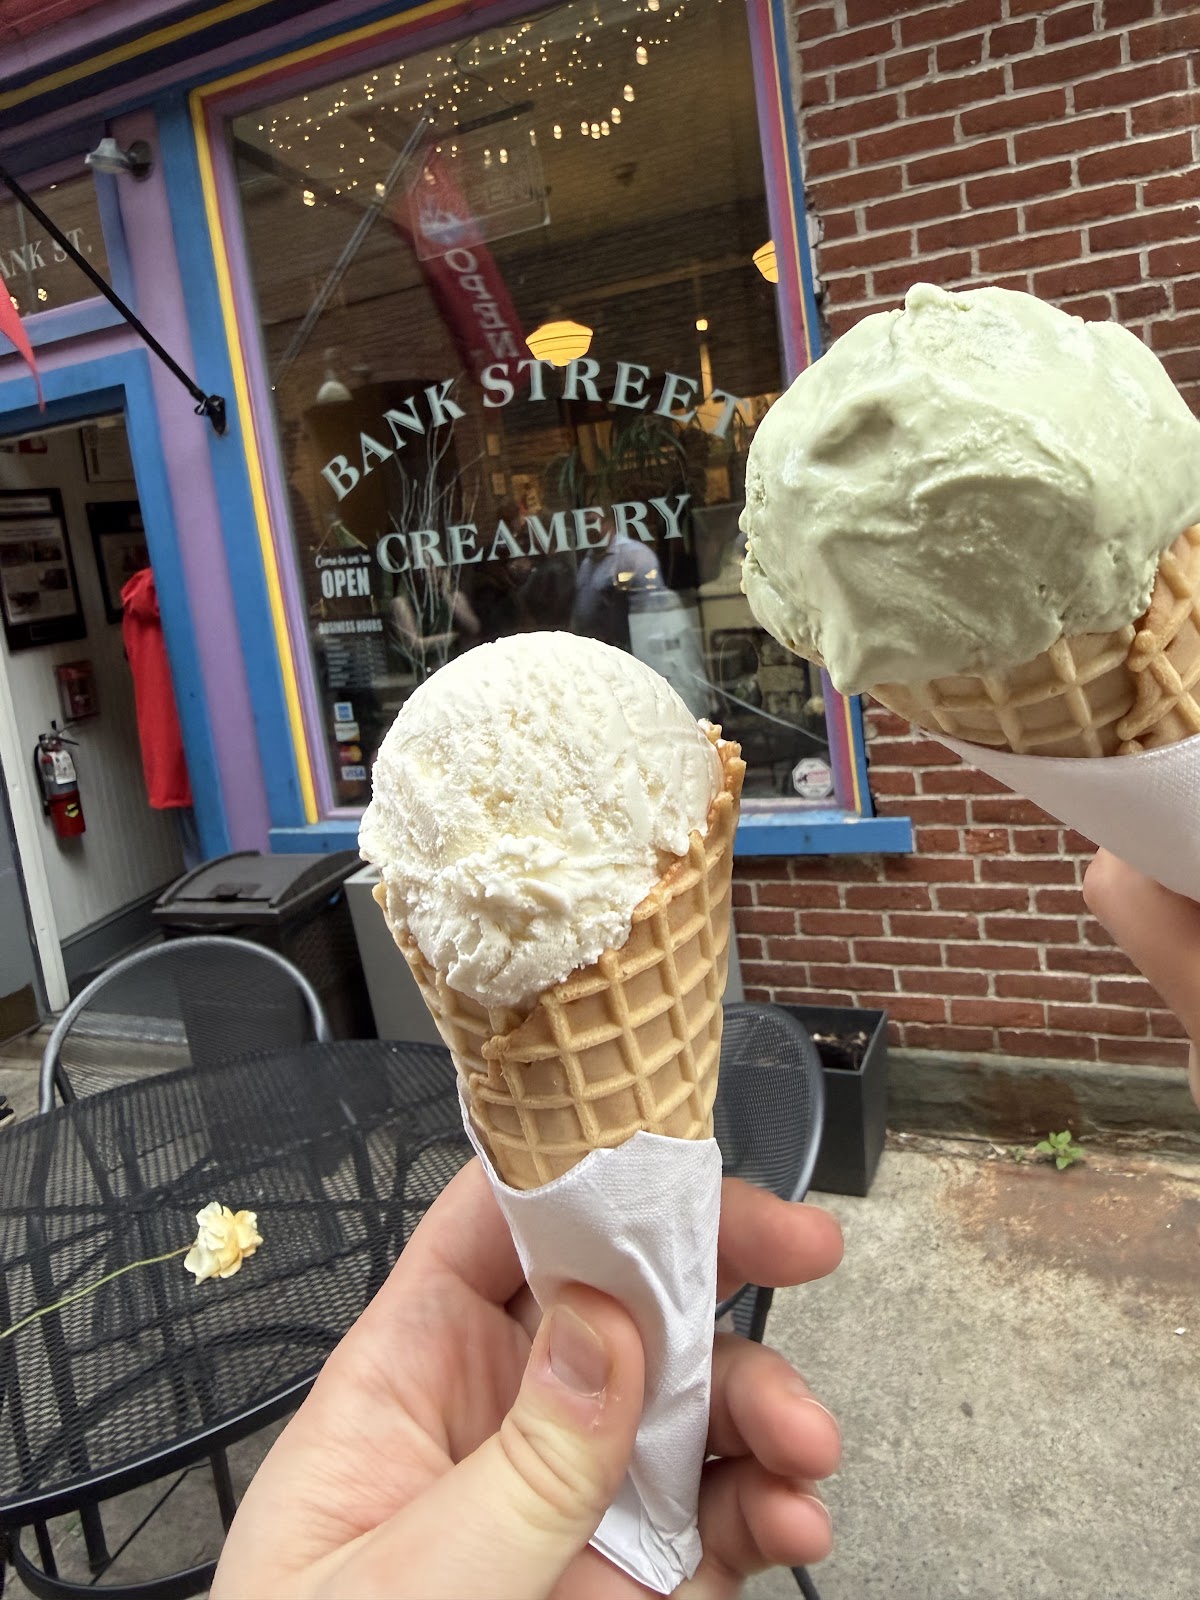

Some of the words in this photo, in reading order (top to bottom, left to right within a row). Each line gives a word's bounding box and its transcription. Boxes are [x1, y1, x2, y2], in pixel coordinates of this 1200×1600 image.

[322, 378, 466, 501] BANK
[480, 358, 749, 440] STREET
[376, 494, 691, 574] CREAMERY
[321, 567, 370, 599] OPEN
